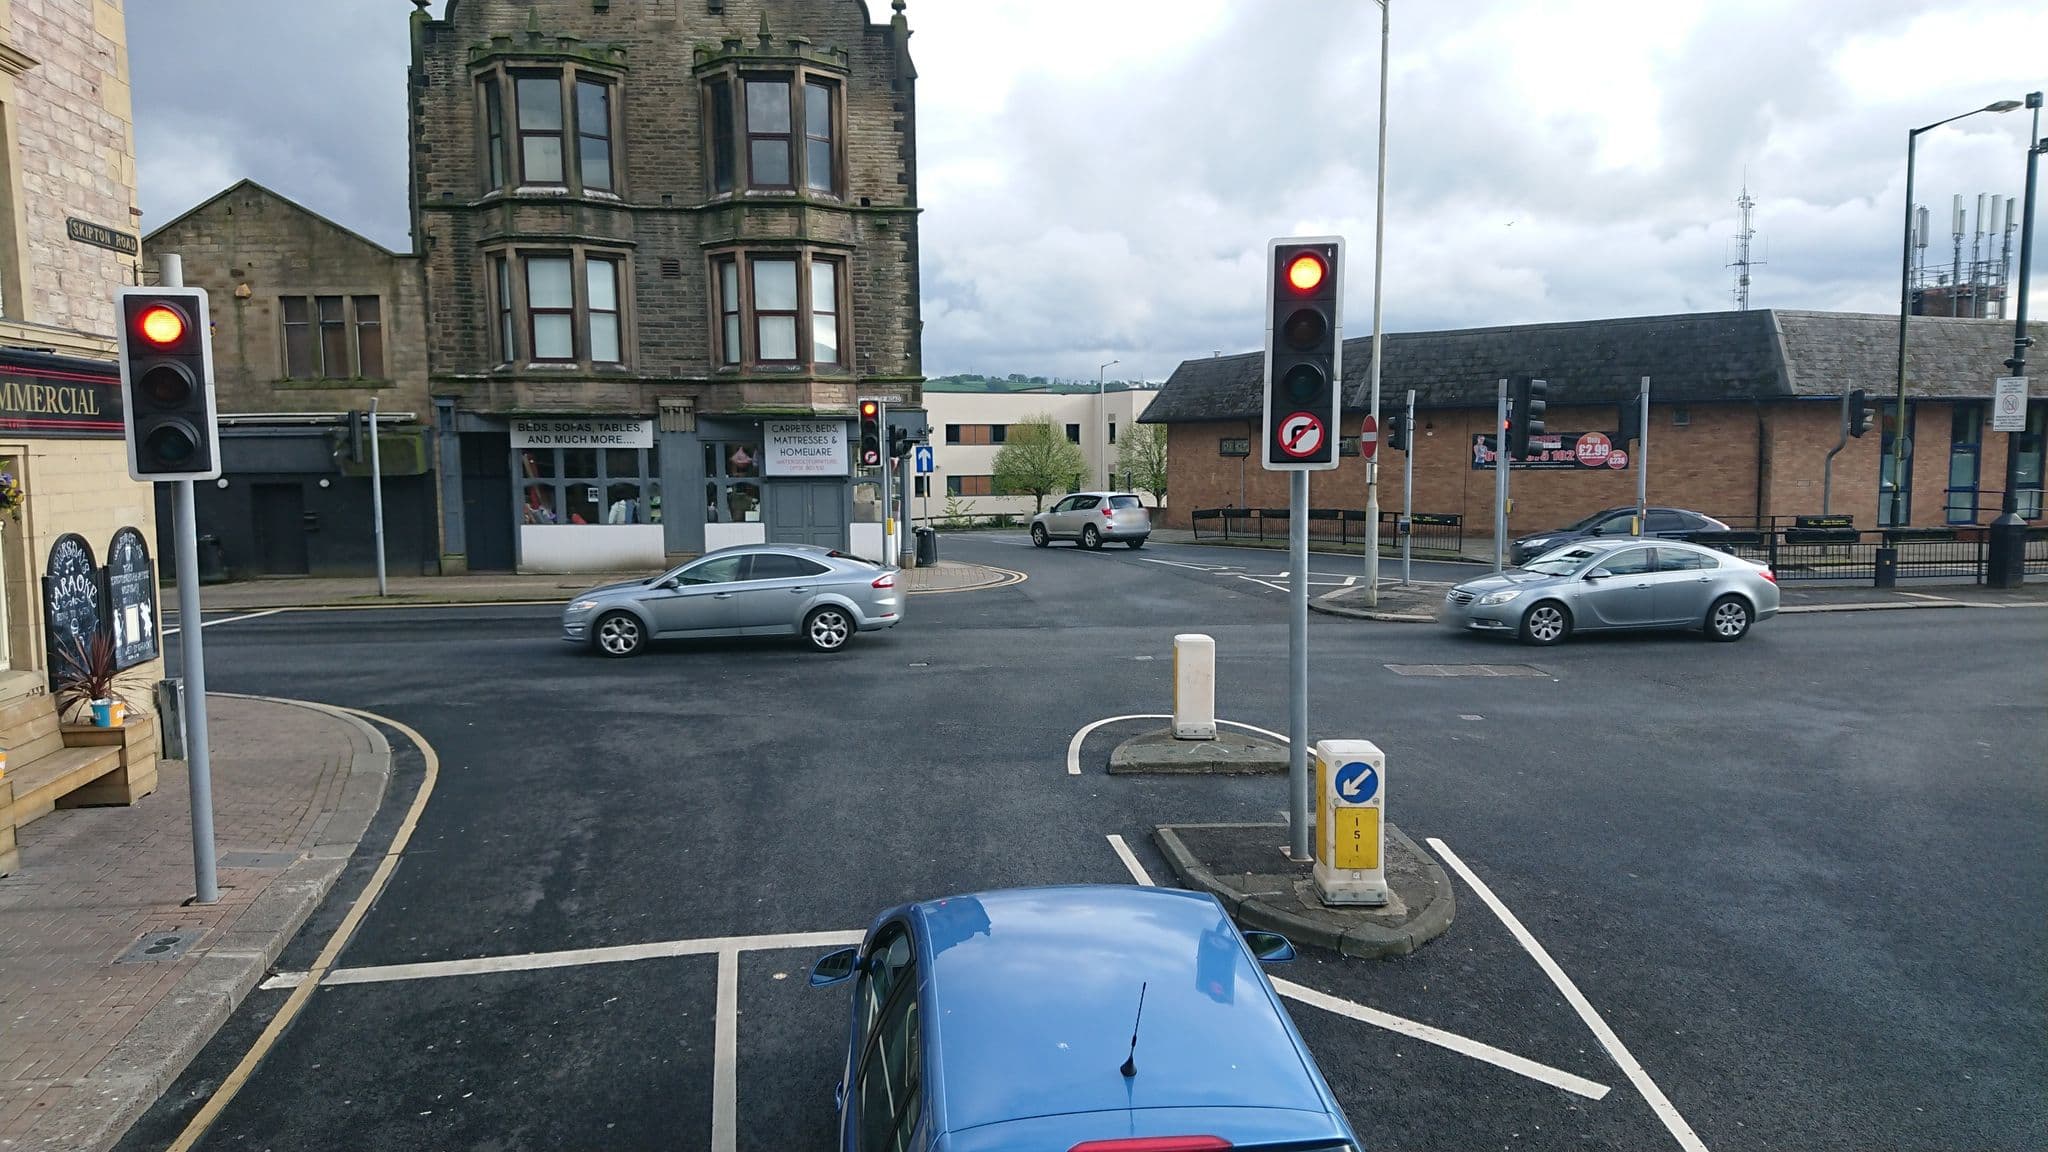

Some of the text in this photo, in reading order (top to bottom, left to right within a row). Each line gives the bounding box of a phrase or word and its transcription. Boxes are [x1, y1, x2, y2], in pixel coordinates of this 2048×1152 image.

[72, 222, 137, 252] SKIPTON ROAD
[0, 382, 100, 415] MMERCIAL
[599, 423, 644, 433] TABLES,
[771, 424, 839, 434] CARPETS, BEDS,
[527, 435, 551, 444] AND
[554, 435, 587, 444] MUCH
[773, 436, 838, 445] MATTRESSES &
[780, 448, 833, 456] HOMEWARE
[1578, 444, 1610, 456] £2.99
[53, 540, 90, 576] THURSDAYS
